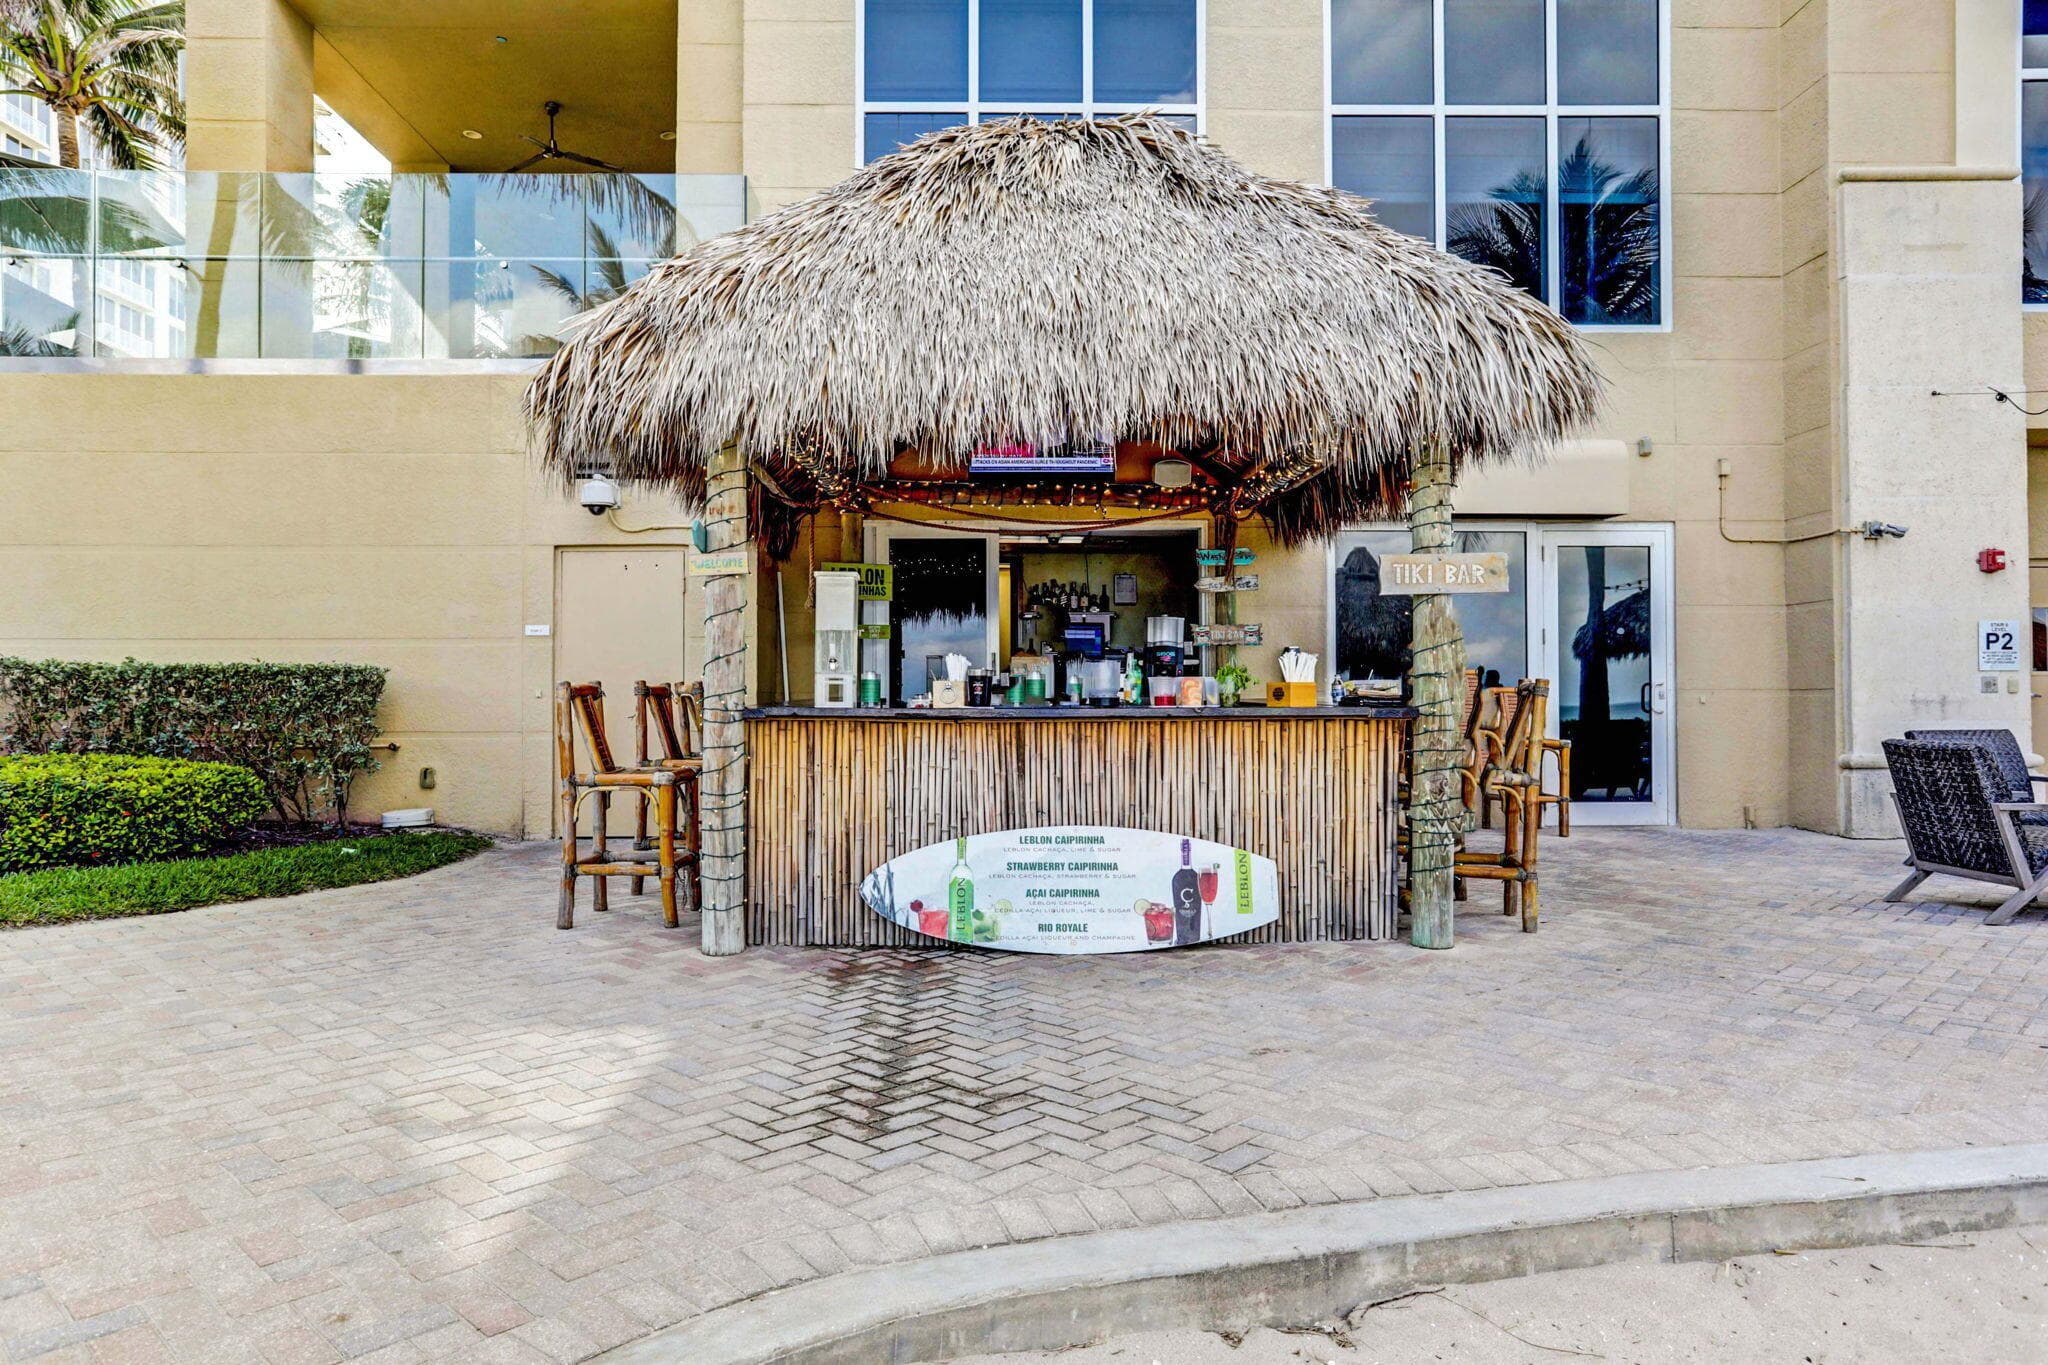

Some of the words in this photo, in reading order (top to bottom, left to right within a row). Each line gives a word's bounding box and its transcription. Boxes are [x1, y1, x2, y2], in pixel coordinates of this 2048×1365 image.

[1393, 563, 1433, 584] TIKI
[1445, 563, 1486, 584] BAR
[1986, 632, 2013, 650] P2
[1019, 835, 1052, 845] LEBLON
[1054, 835, 1105, 845] CAIPIRINHA
[1006, 862, 1065, 871] STRAWBERRY
[1068, 862, 1119, 871] CAIPIRINHA
[1239, 853, 1250, 908] LEBLON
[1025, 888, 1047, 899] AÇAI
[1049, 888, 1100, 898] CAIPIRINHA
[957, 877, 967, 930] LEBLON
[1038, 923, 1053, 933] RIO
[1055, 923, 1088, 933] ROYALE
